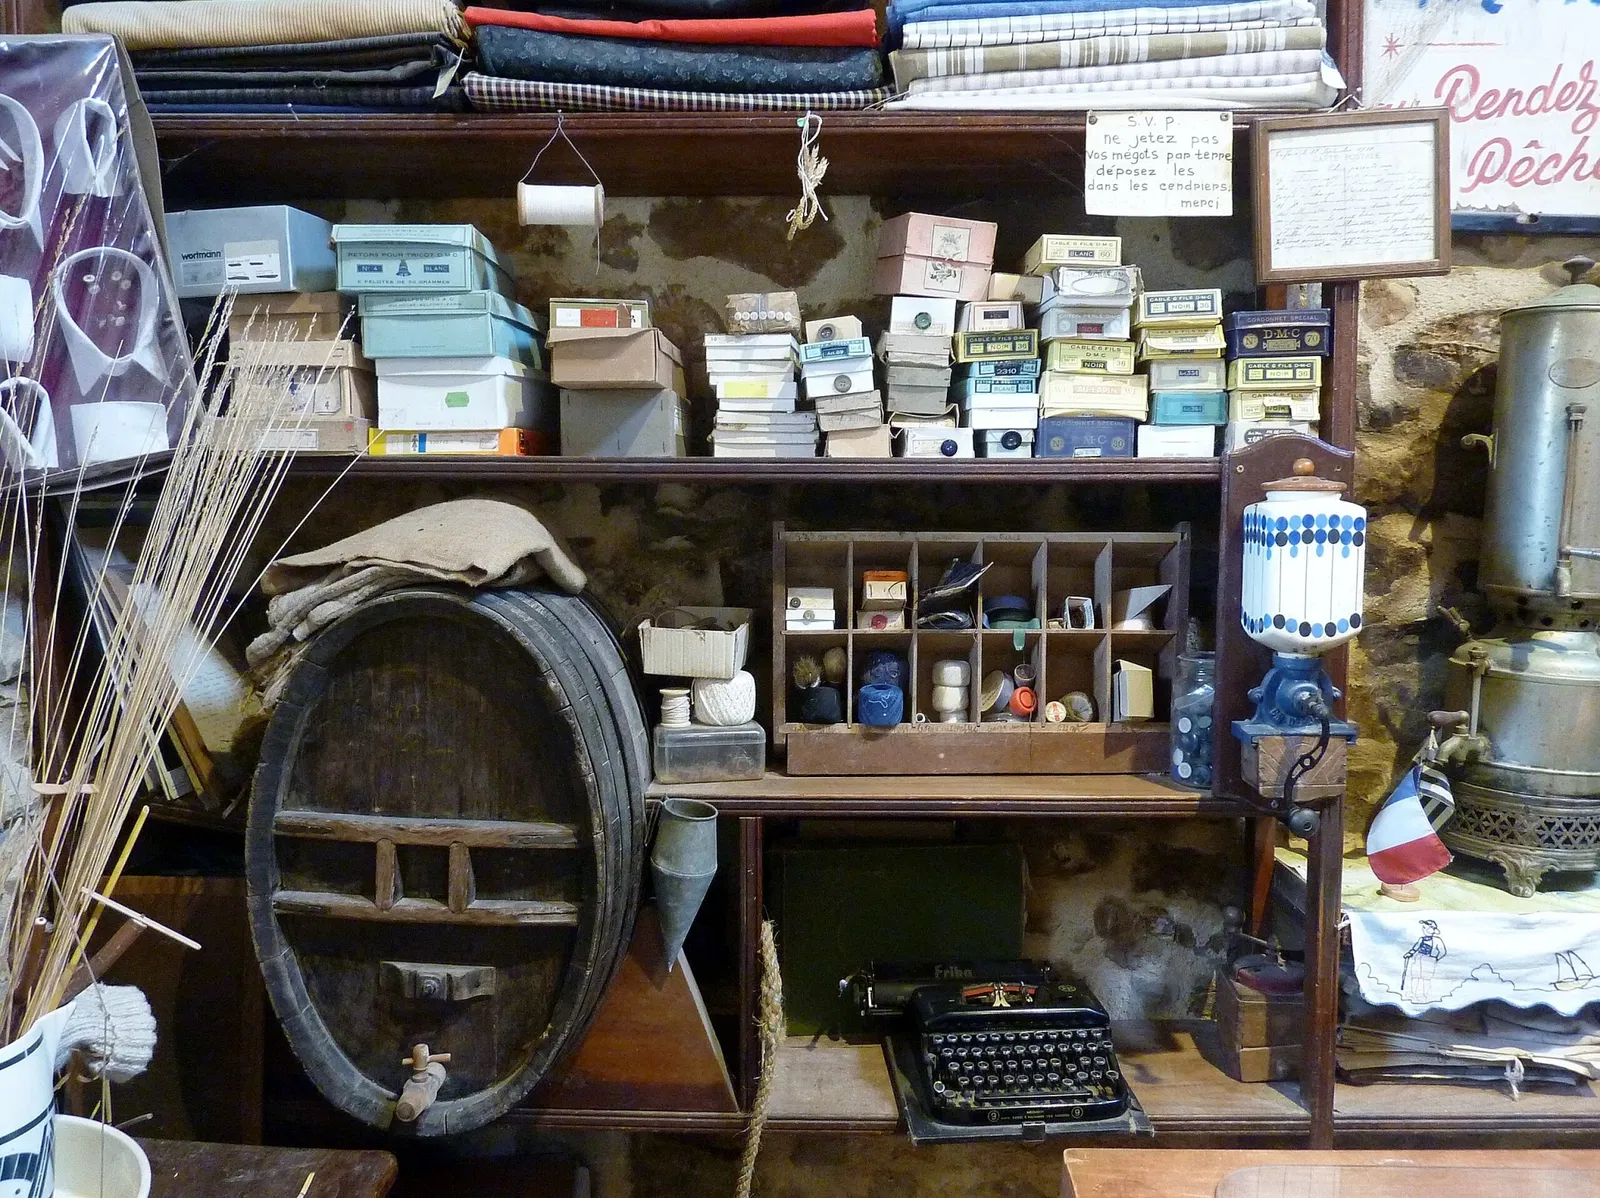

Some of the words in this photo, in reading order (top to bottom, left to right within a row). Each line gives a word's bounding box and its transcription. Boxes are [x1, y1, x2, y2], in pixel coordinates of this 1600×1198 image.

[1104, 134, 1121, 144] ne
[1128, 132, 1177, 149] jetez
[1191, 135, 1219, 149] pas
[1086, 150, 1107, 160] Vos
[1112, 148, 1159, 164] mégots
[1167, 151, 1190, 164] par
[1096, 164, 1157, 179] déposez
[1173, 162, 1195, 176] les
[1087, 178, 1119, 191] dans
[1129, 179, 1148, 191] les
[1181, 197, 1220, 210] merci
[181, 250, 222, 260] wortmann
[1307, 334, 1317, 342] 70
